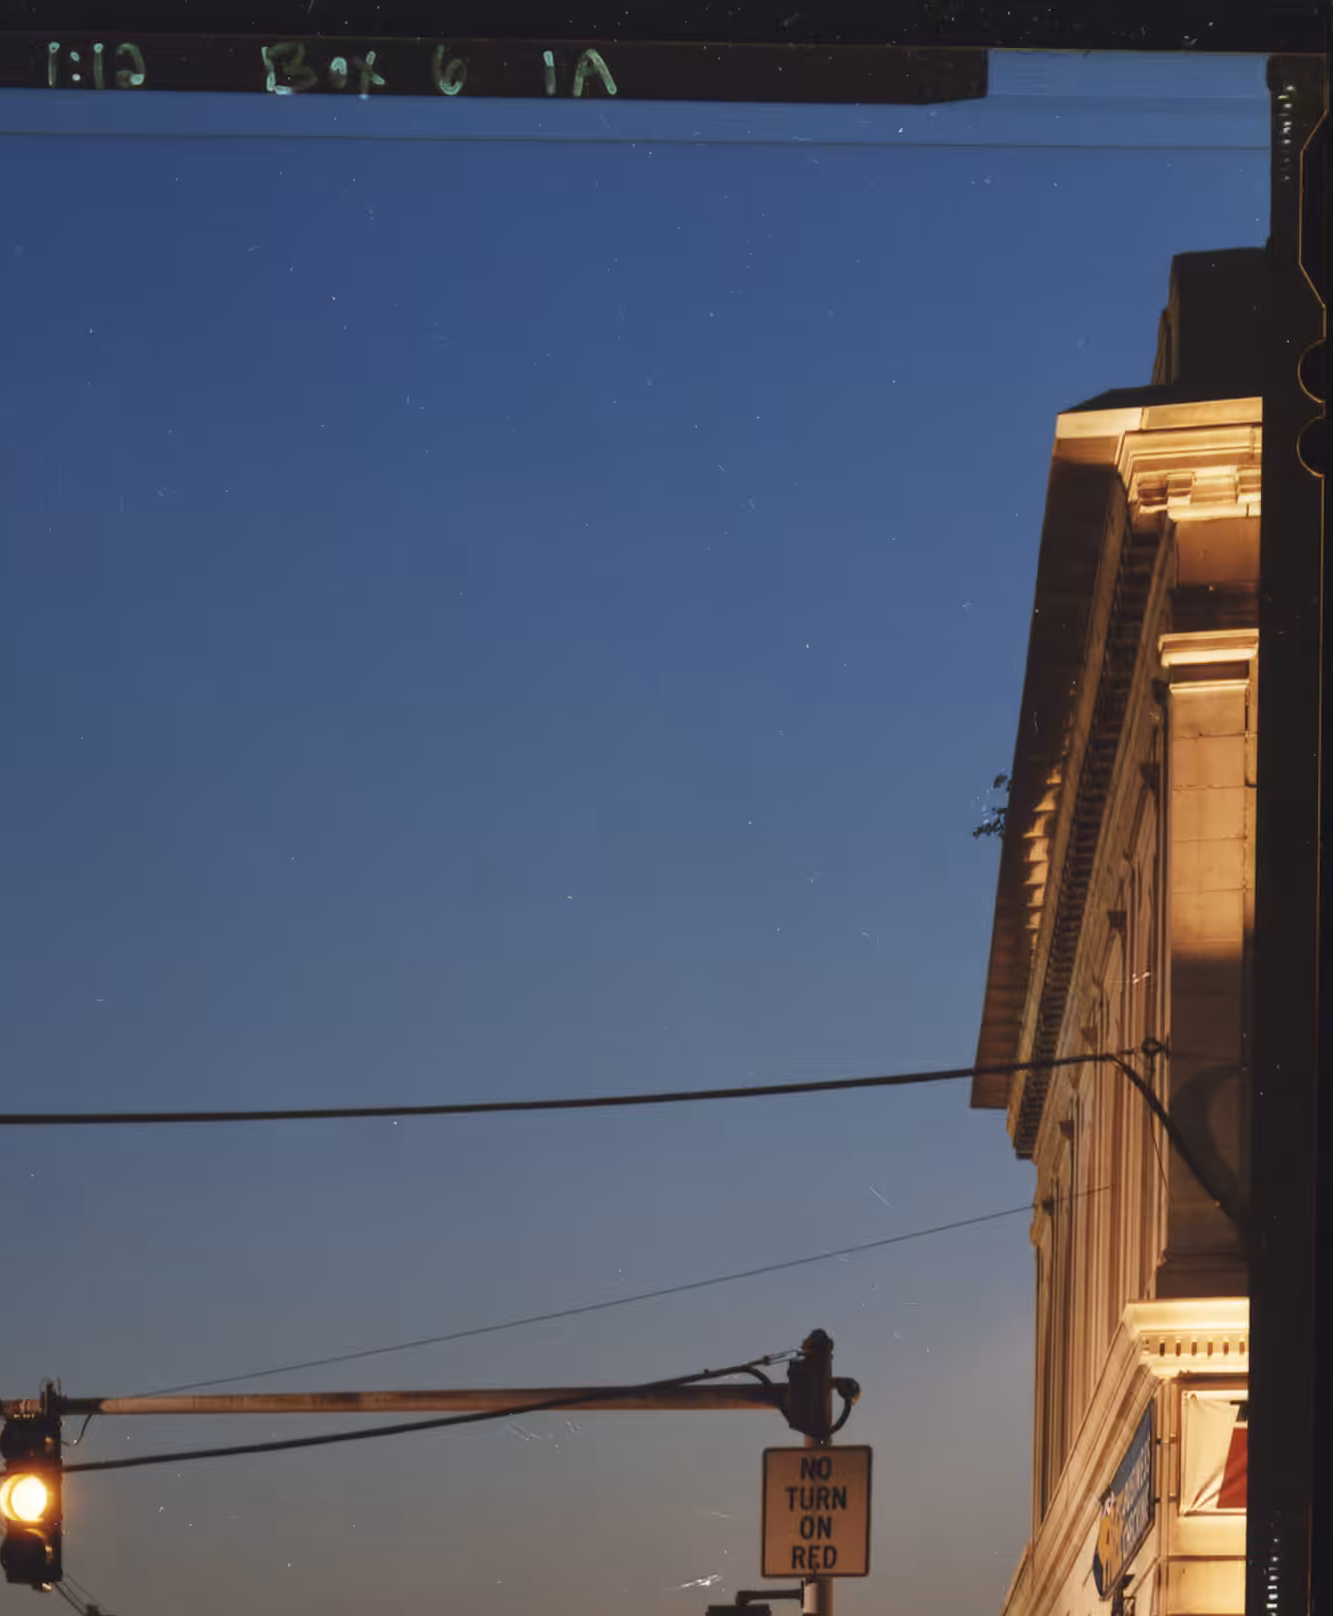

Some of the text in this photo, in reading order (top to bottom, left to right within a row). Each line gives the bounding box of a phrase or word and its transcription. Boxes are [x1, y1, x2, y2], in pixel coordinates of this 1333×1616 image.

[800, 1456, 832, 1481] NO
[785, 1486, 847, 1511] TURN
[800, 1515, 832, 1540] ON
[791, 1546, 838, 1570] RED
